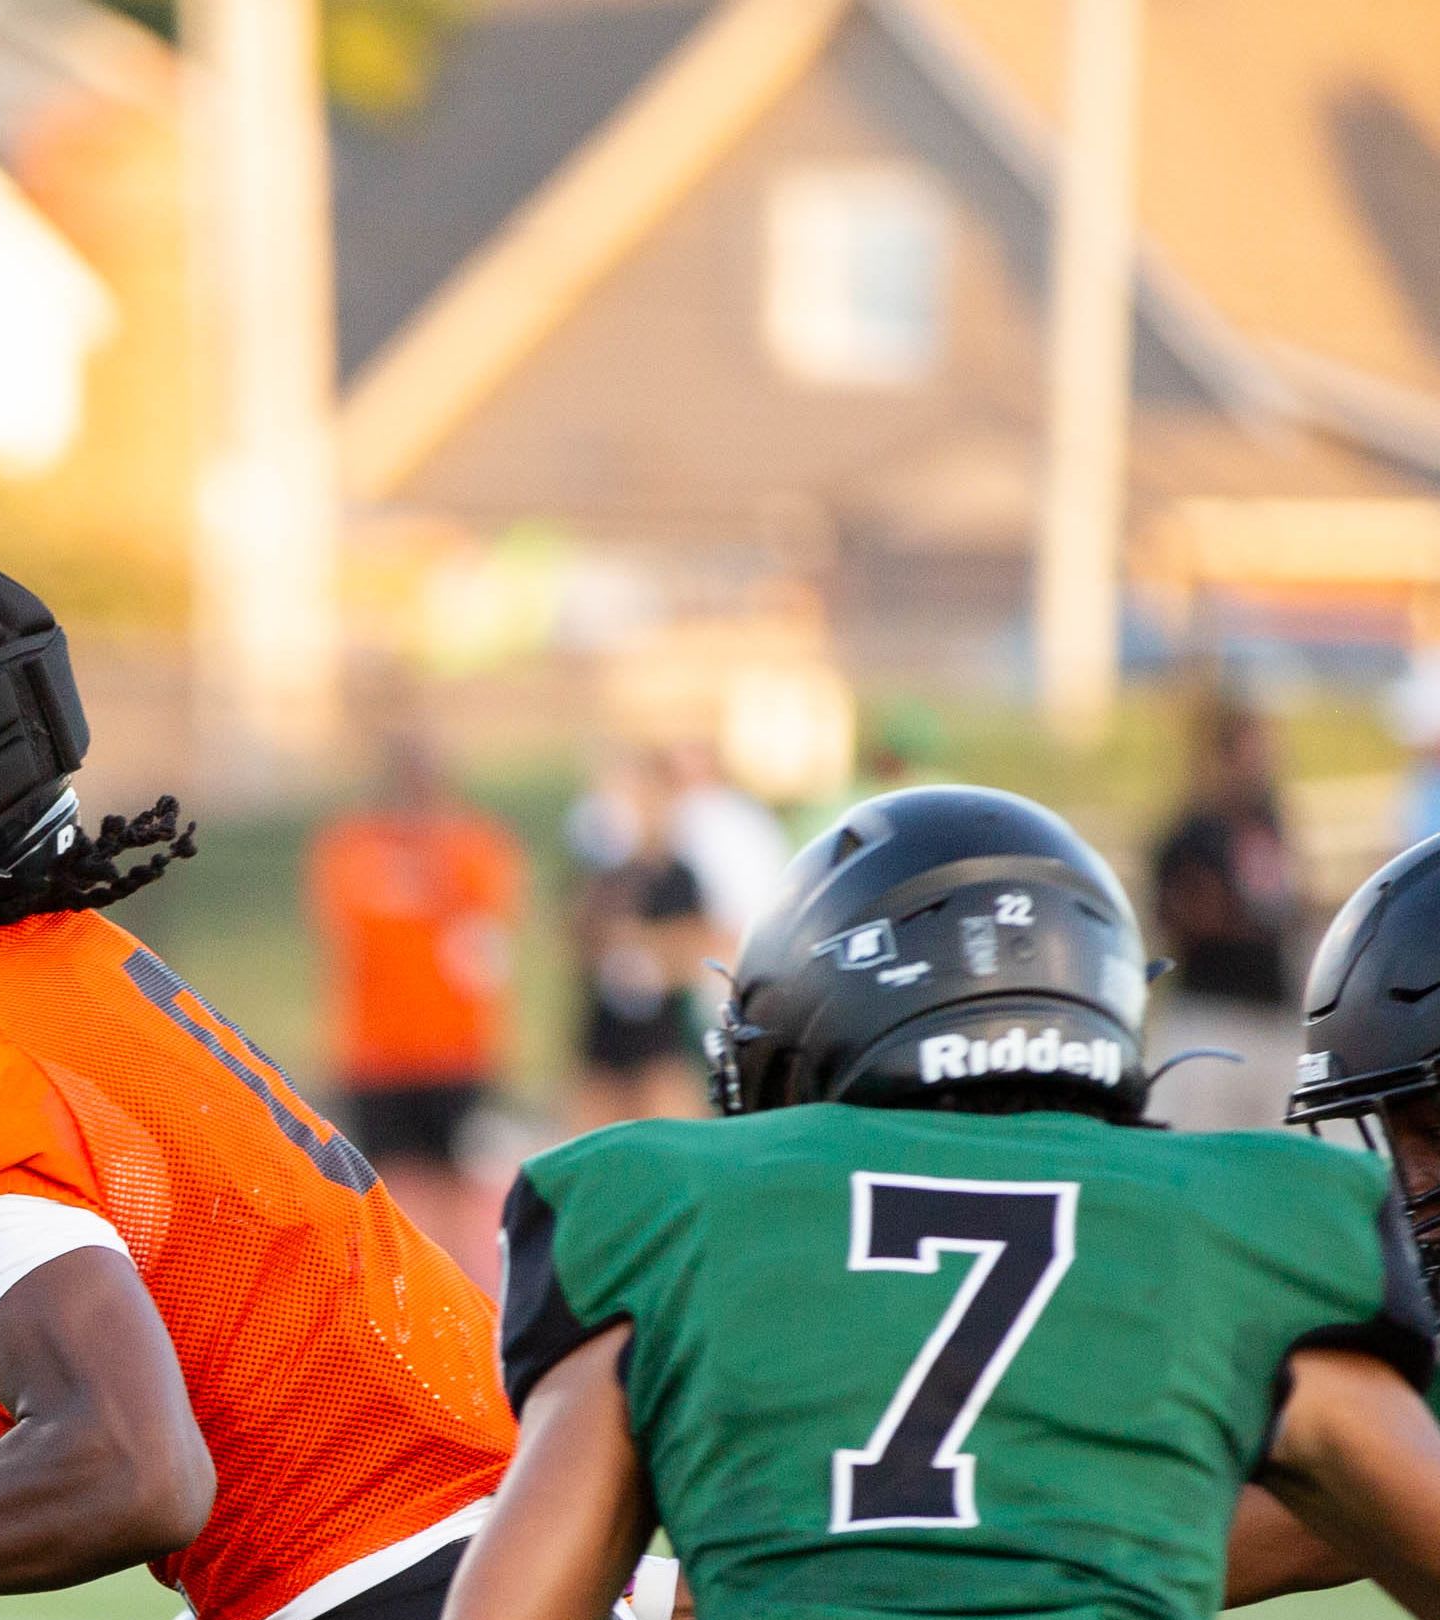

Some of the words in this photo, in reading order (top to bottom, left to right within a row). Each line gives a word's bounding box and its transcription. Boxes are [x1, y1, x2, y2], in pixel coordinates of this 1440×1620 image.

[995, 893, 1037, 927] 22
[920, 1027, 1121, 1087] Riddell
[829, 1170, 1081, 1534] 7
